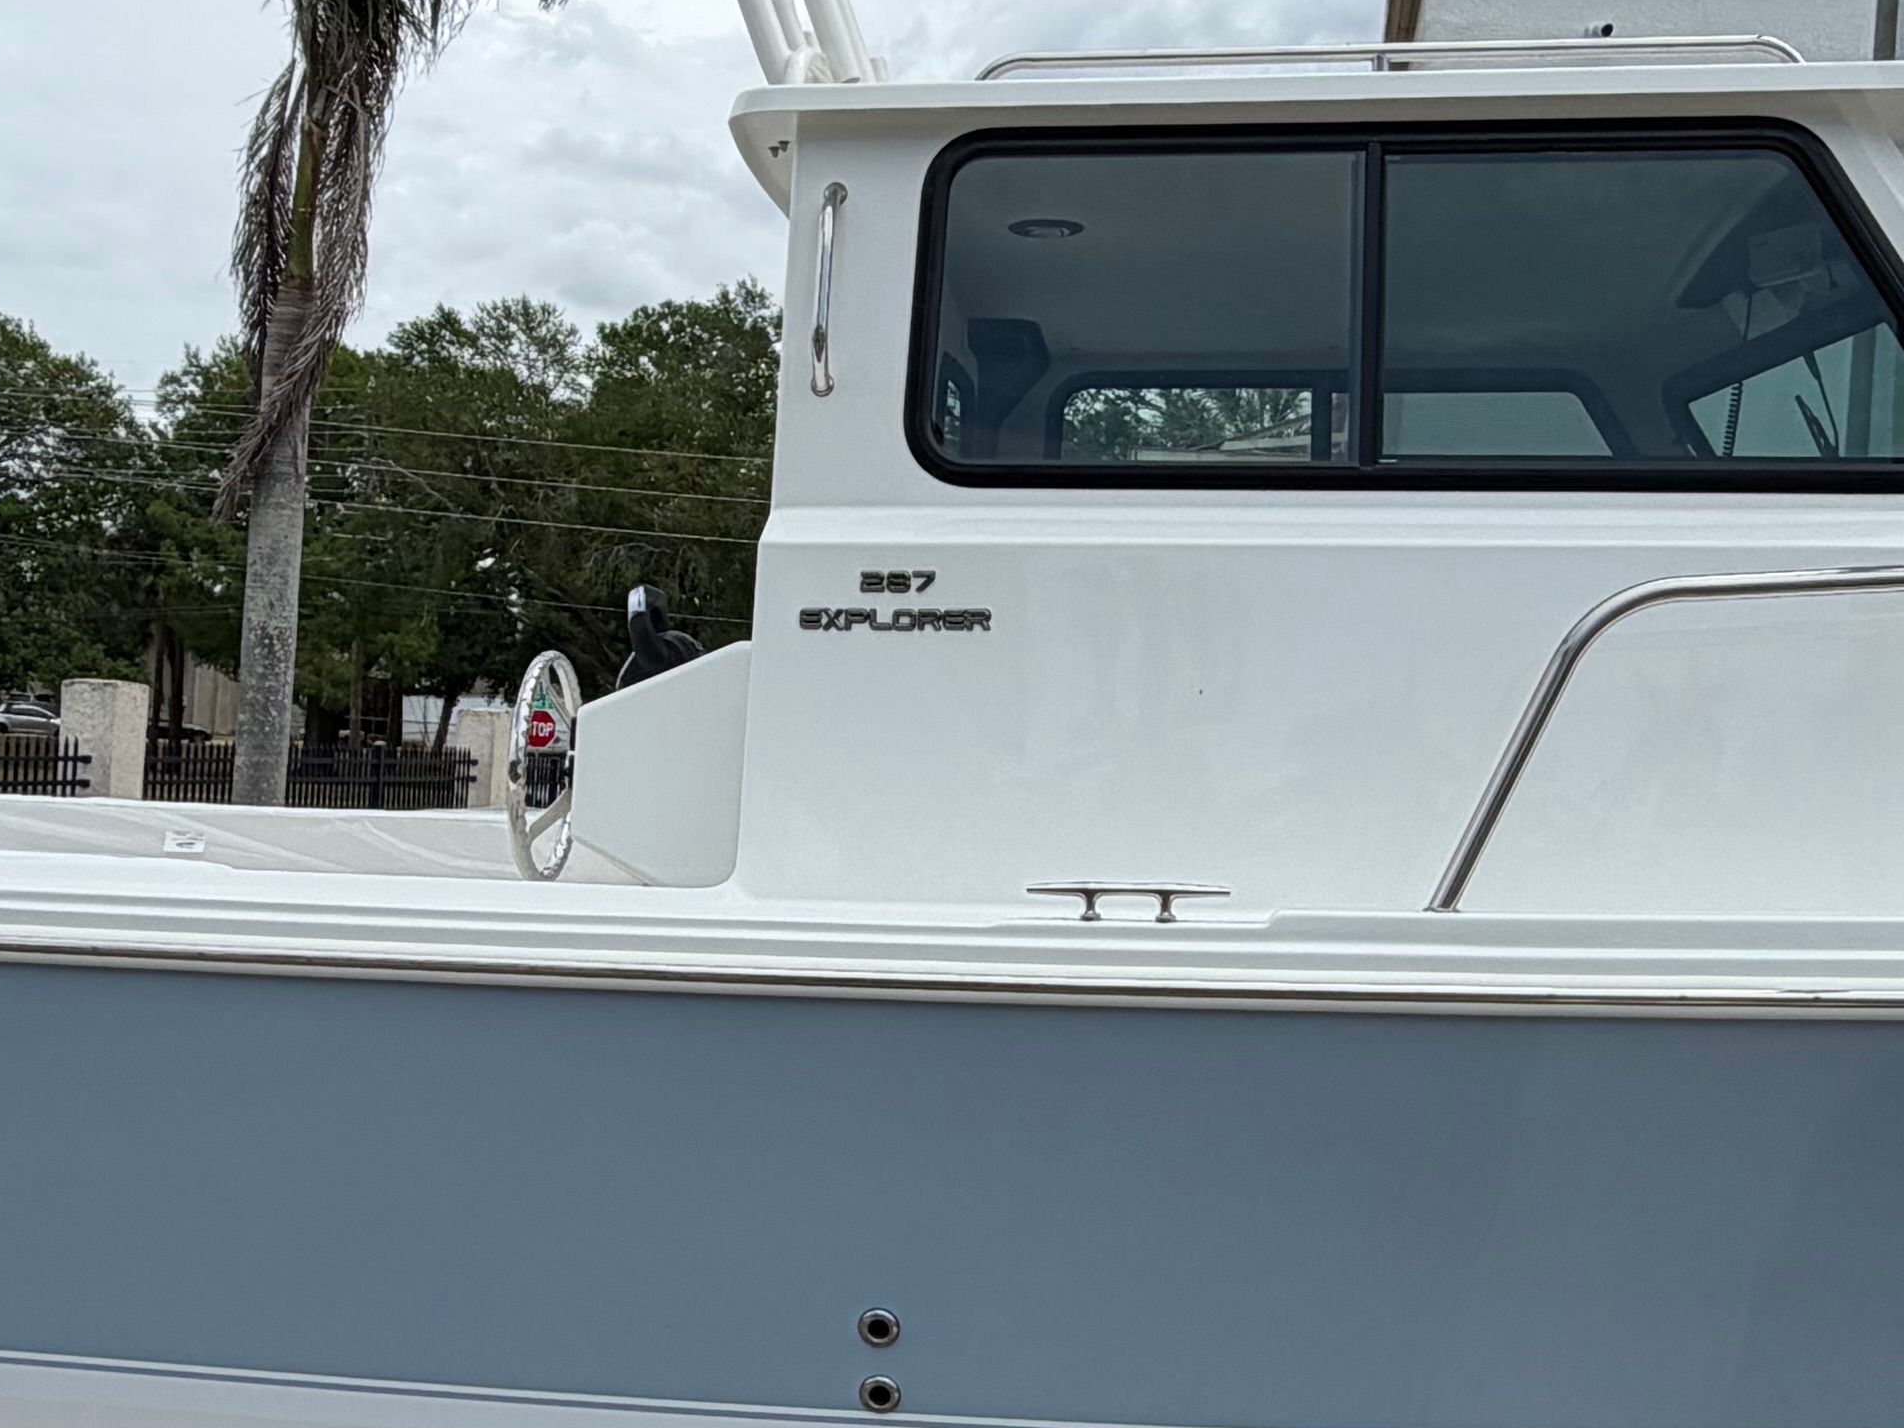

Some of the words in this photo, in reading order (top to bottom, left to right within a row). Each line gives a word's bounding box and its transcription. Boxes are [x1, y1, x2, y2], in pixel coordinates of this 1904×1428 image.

[859, 570, 936, 593] 287
[799, 607, 992, 631] EXPLORER
[532, 721, 553, 737] TOP
